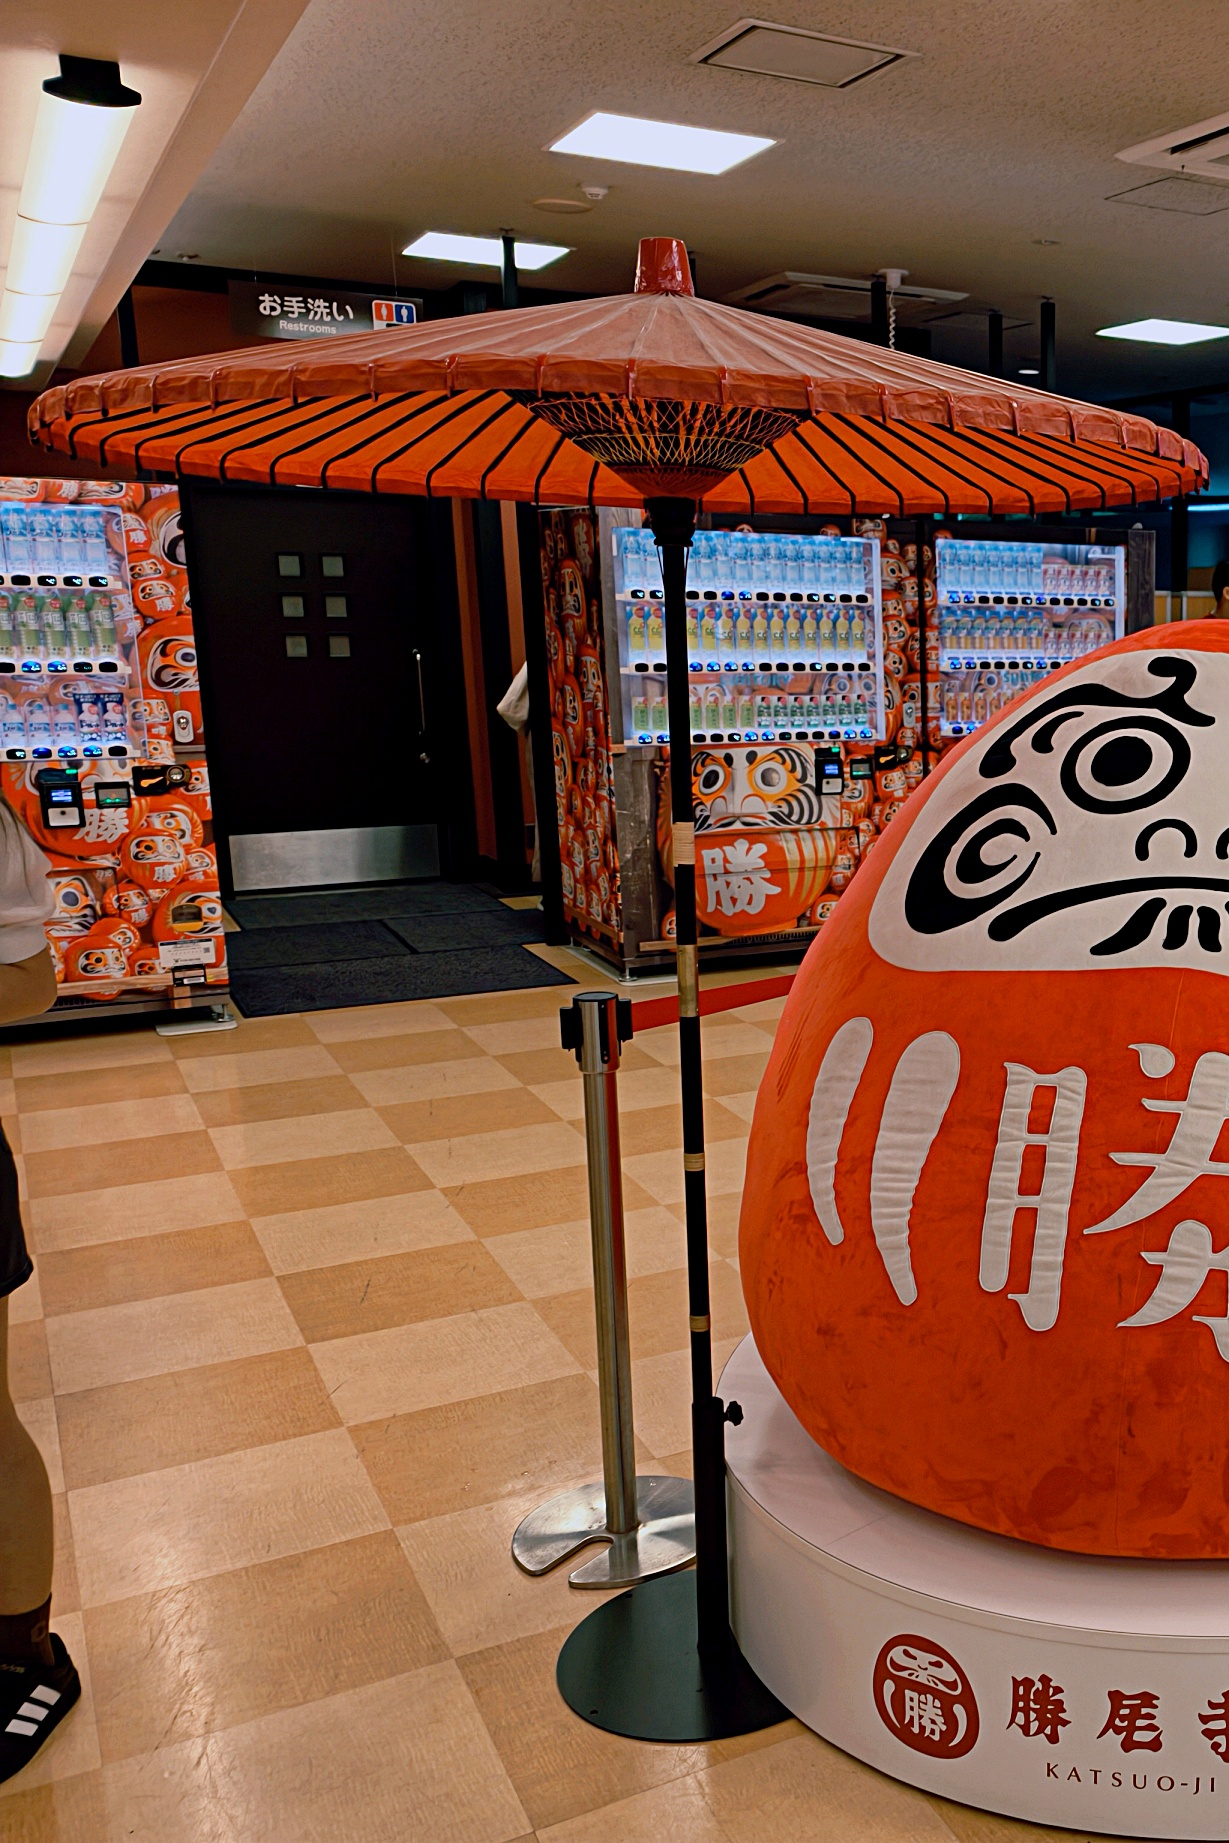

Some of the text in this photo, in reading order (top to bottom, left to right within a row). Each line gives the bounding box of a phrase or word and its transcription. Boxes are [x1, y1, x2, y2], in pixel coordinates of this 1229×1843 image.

[258, 293, 354, 322] お手洗い
[279, 320, 337, 334] Restrooms
[72, 807, 130, 844] 勝
[701, 838, 782, 916] 勝
[904, 1689, 947, 1742] 勝
[1046, 1762, 1217, 1796] KATSUO-JI
